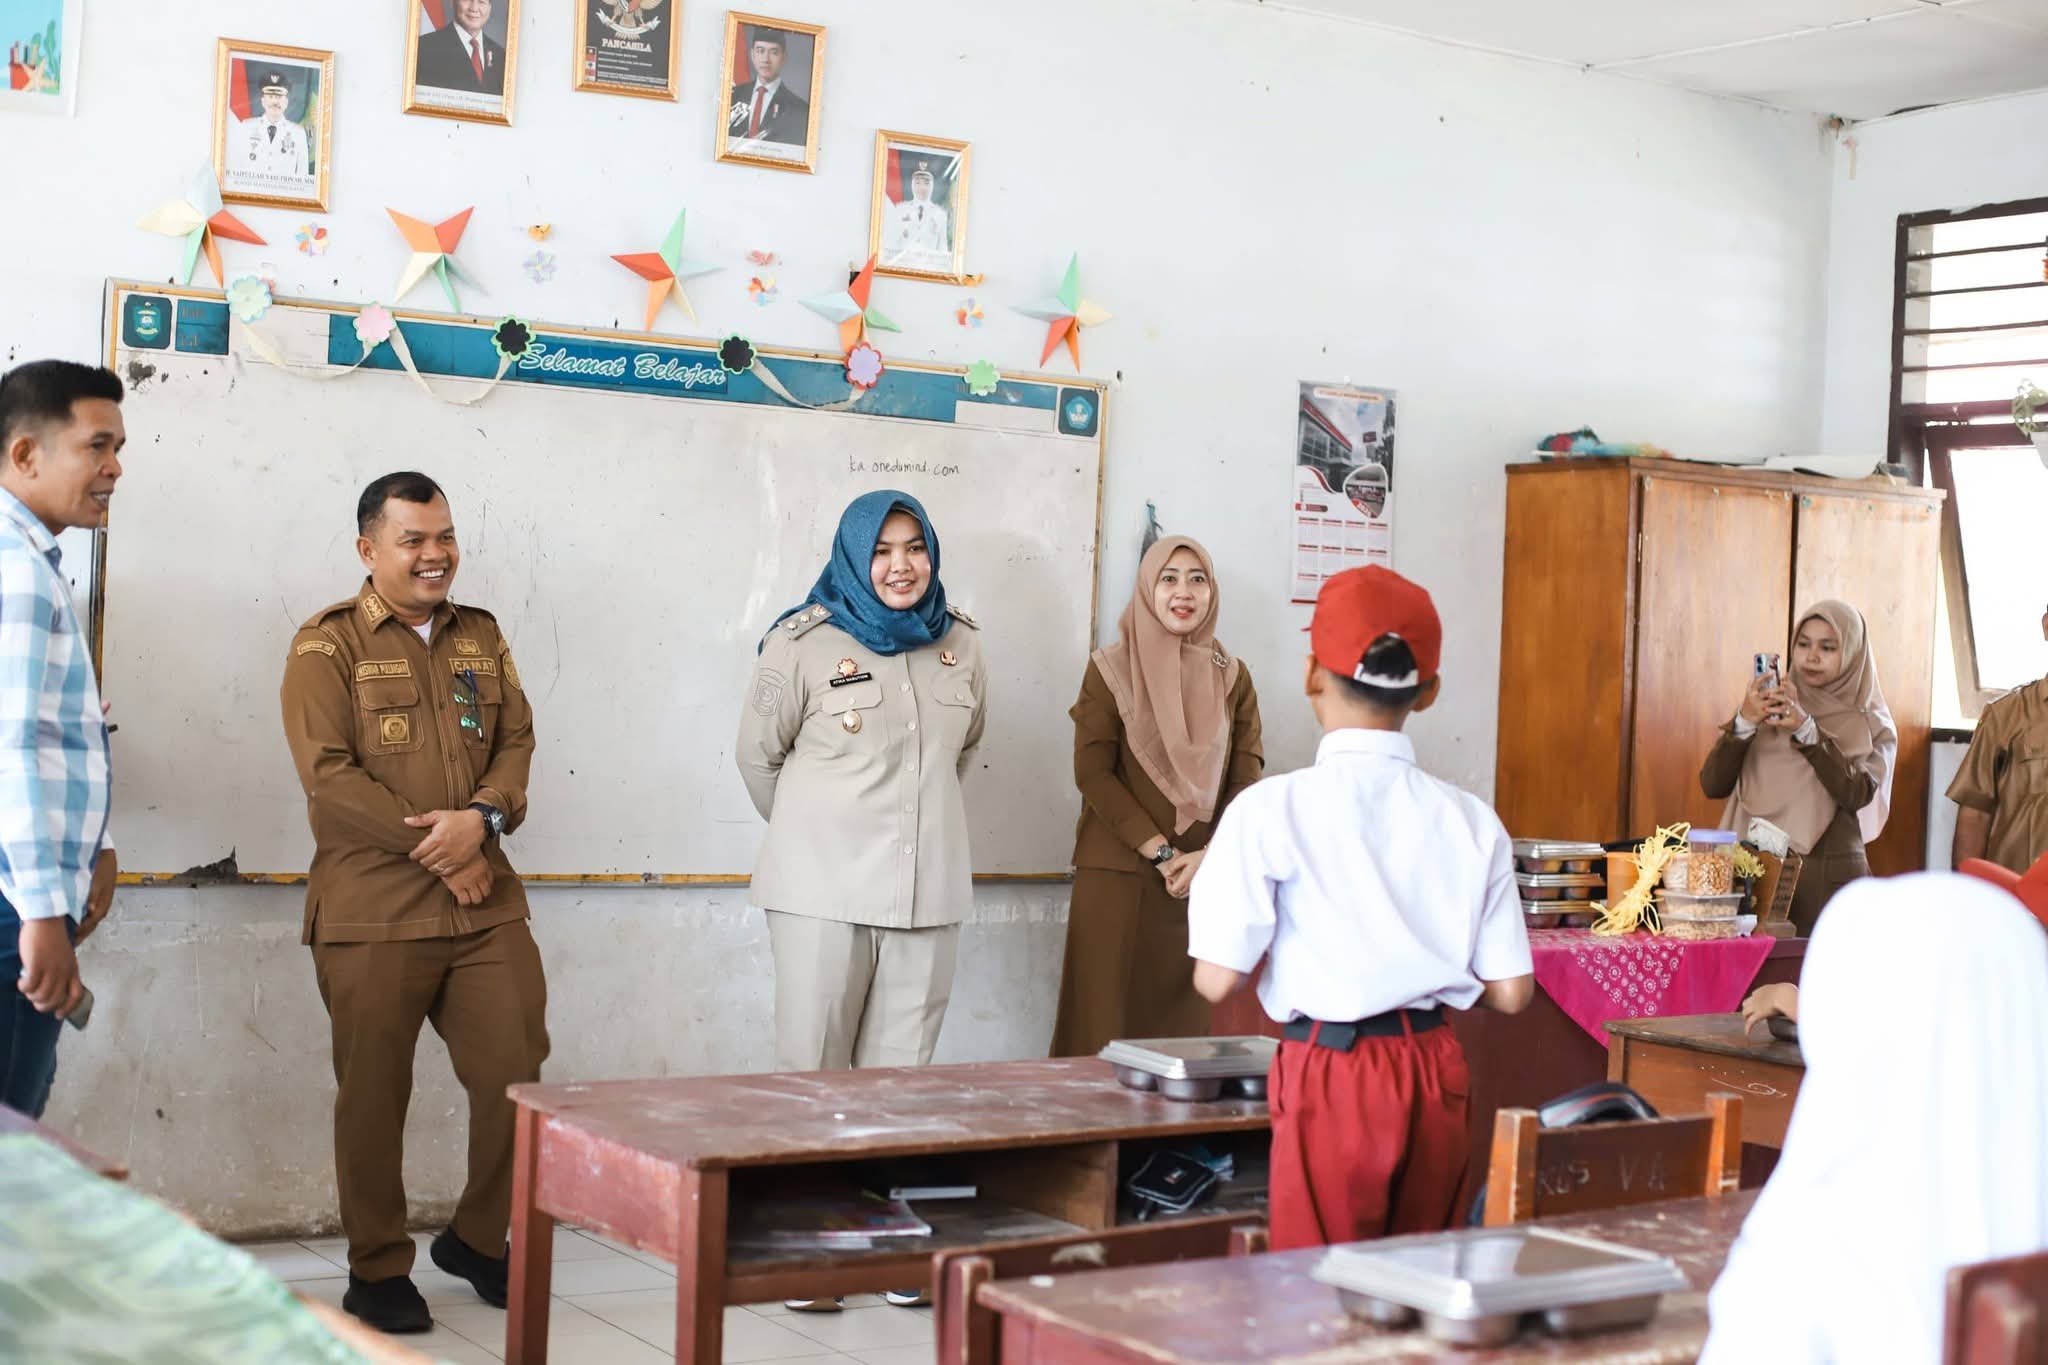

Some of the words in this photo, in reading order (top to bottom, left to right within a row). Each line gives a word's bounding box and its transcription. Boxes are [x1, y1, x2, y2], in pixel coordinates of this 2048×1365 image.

[519, 344, 627, 376] Selamat
[634, 353, 726, 389] Belajar
[455, 660, 494, 673] CAMAT
